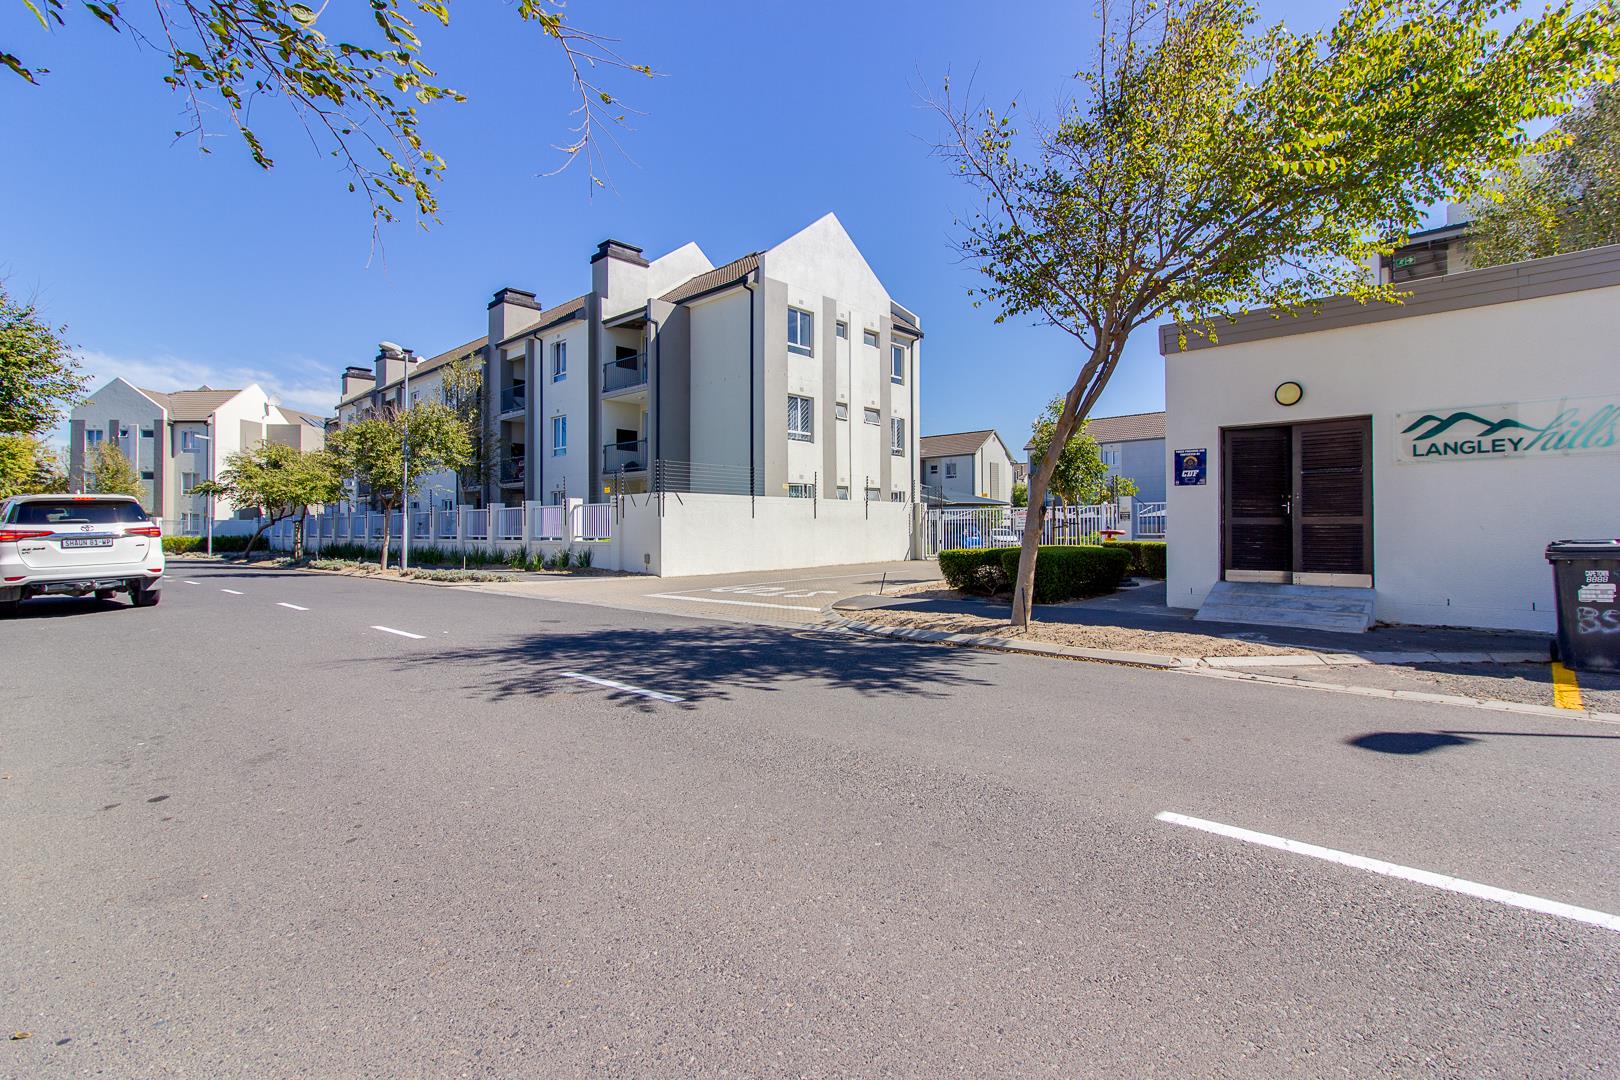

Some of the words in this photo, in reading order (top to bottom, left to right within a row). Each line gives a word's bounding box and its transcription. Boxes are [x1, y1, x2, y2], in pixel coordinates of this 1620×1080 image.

[1412, 437, 1525, 457] LANGLEY
[1523, 403, 1620, 452] hills
[65, 539, 88, 547] SHAUN
